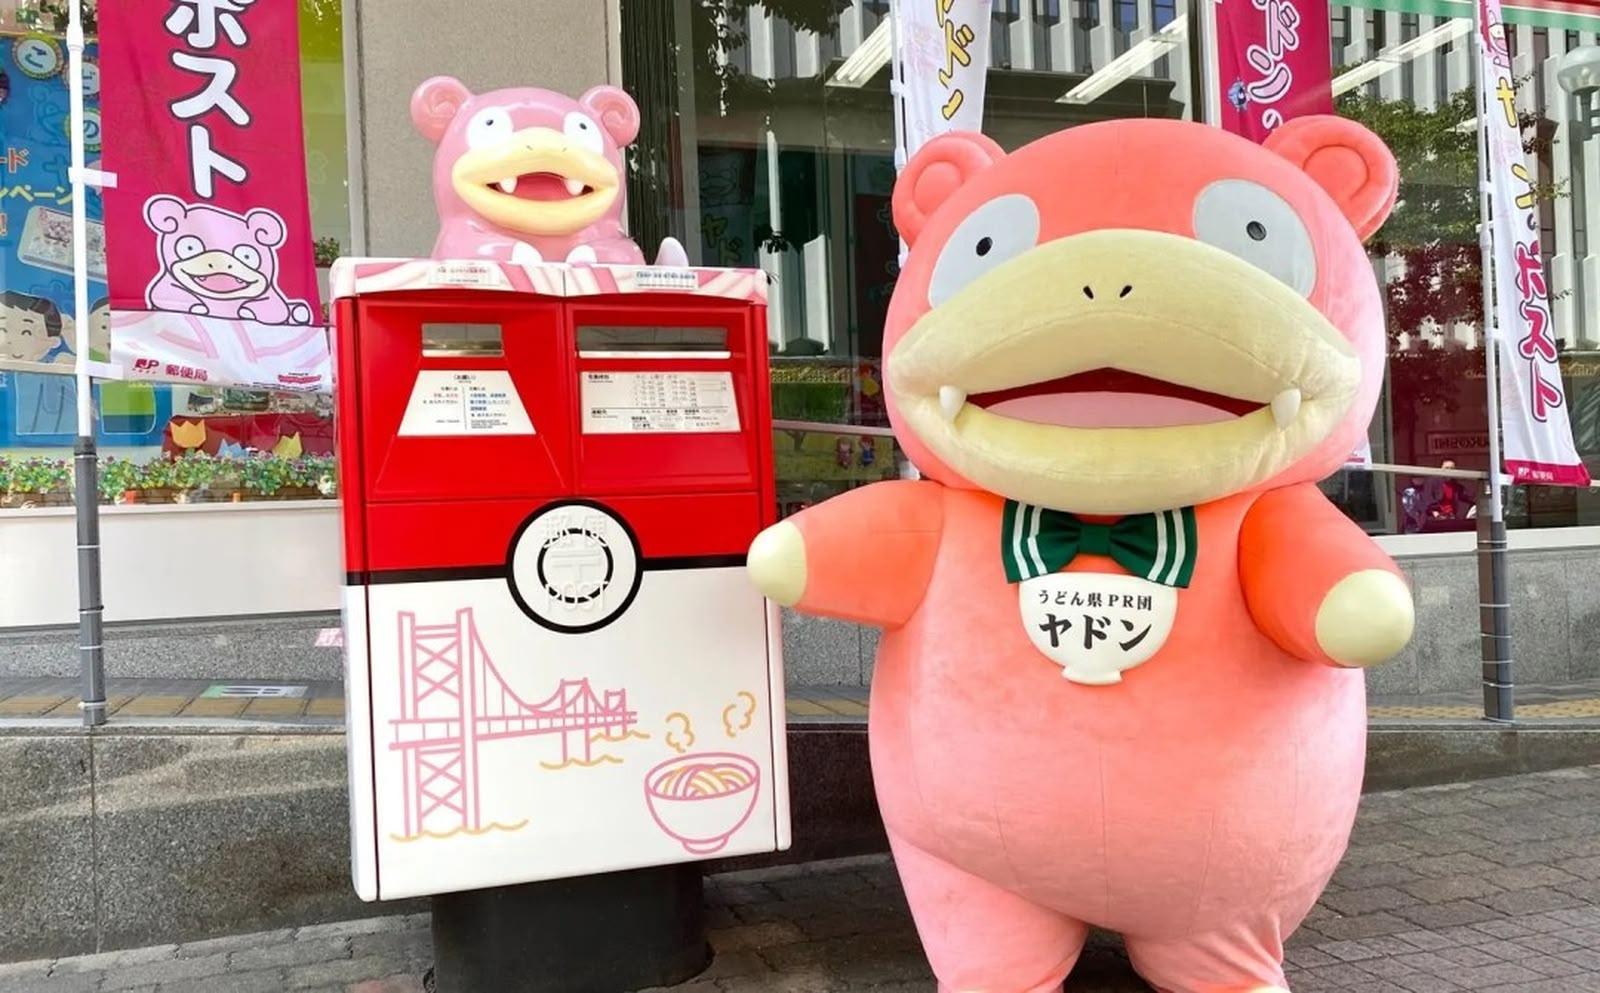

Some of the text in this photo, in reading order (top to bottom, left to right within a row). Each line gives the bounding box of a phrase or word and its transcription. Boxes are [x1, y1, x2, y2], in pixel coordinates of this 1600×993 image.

[165, 364, 208, 382] 郵便局
[1039, 589, 1152, 612] うどん県PR団
[1039, 613, 1152, 652] ヤドン
